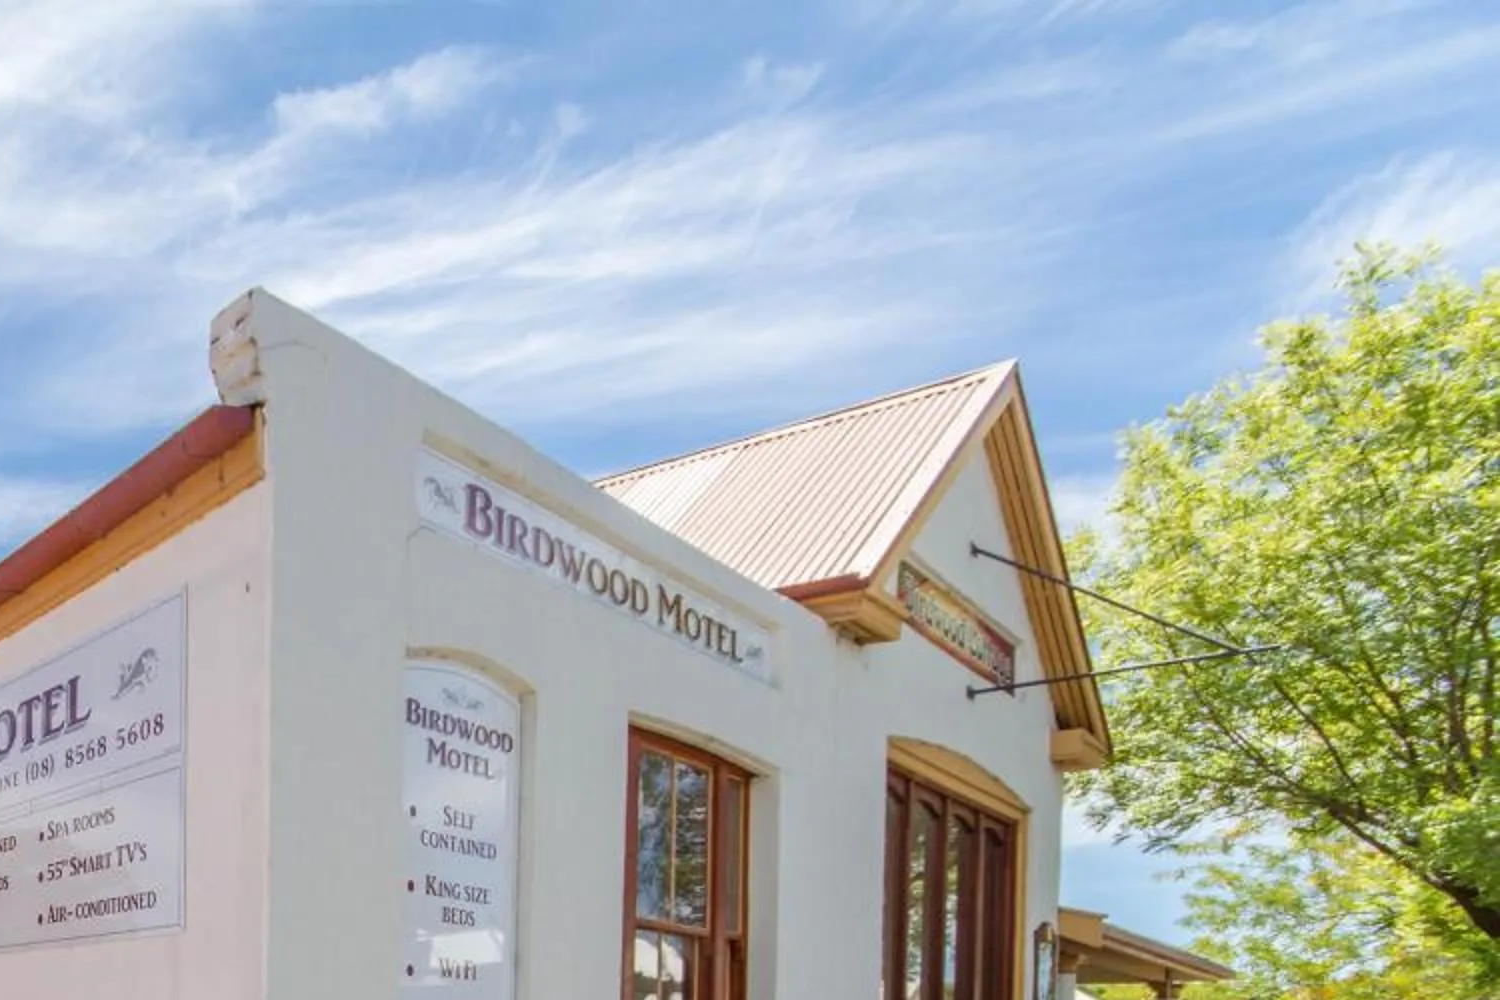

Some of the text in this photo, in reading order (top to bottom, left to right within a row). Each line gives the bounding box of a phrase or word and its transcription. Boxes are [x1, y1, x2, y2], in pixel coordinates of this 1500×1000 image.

[463, 482, 743, 663] BIRDWOOD MOTEL
[25, 754, 55, 785] (08)
[65, 736, 107, 768] 8568
[116, 713, 165, 750] 5608
[405, 697, 513, 779] BIRDWOOD MOTEL
[47, 807, 116, 841] SPA ROOMS
[443, 805, 476, 831] SELF
[421, 830, 497, 860] CONTAINED
[425, 875, 491, 905] KING SIZE
[442, 906, 476, 928] BEDS
